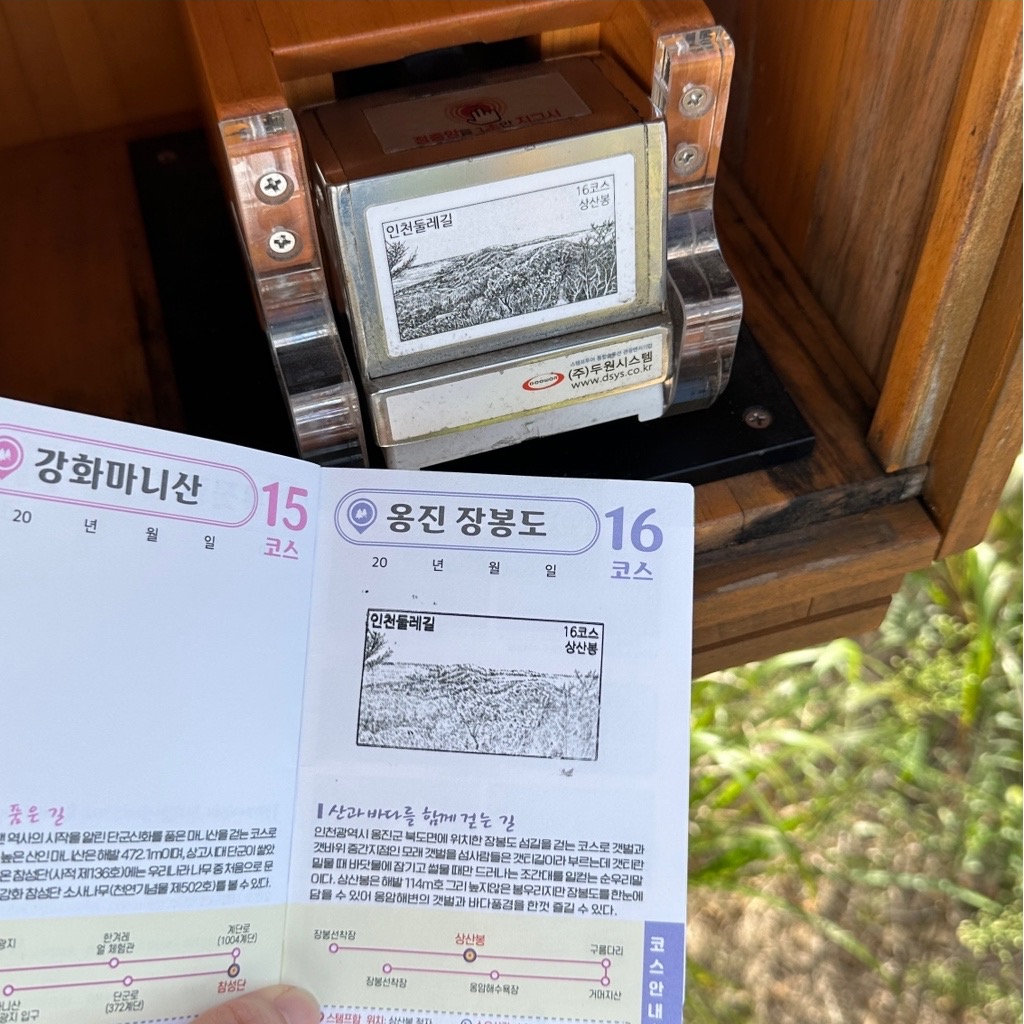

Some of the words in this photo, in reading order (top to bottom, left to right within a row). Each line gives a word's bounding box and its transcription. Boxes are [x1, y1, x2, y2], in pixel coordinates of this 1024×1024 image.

[516, 108, 562, 126] 지그시
[576, 181, 610, 200] 16코스
[579, 193, 611, 213] 상산봉
[386, 213, 454, 240] 인천둘레길
[568, 351, 653, 381] (주)두원시스템
[571, 364, 653, 389] www.dsys.co.kr
[34, 447, 203, 505] 강화마니산
[262, 481, 309, 532] 15
[12, 509, 32, 524] 20
[84, 518, 97, 534] 년
[146, 527, 158, 543] 월
[204, 535, 215, 551] 일
[263, 536, 298, 560] 코스
[386, 503, 446, 534] 옹진
[455, 507, 547, 537] 장봉도
[604, 506, 664, 553] 16
[371, 556, 388, 569] 20
[432, 558, 444, 573] 년
[488, 560, 500, 576] 월
[545, 563, 557, 578] 일
[610, 561, 654, 582] 코스
[370, 614, 436, 632] 인천둘레길
[564, 625, 600, 641] 16코스
[565, 641, 599, 656] 상산봉
[9, 803, 40, 827] 품은
[48, 806, 65, 827] 길
[328, 804, 365, 820] 산과
[367, 806, 416, 827] 바다를
[421, 806, 456, 826] 함께
[461, 812, 492, 829] 걷는
[499, 814, 516, 832] 길
[8, 833, 43, 844] 역사의
[46, 832, 80, 843] 시작을
[83, 832, 105, 843] 알린
[108, 831, 162, 843] 단군신화를
[165, 831, 185, 842] 품은
[188, 829, 230, 841] 마니산을
[229, 829, 248, 840] 걷는
[251, 828, 276, 839] 코스로
[315, 827, 368, 838] 인천광역시
[372, 829, 402, 841] 옹진군
[406, 832, 448, 843] 북도면에
[451, 834, 482, 846] 위치한
[485, 836, 516, 847] 장봉도
[519, 838, 551, 849] 섬길을
[554, 840, 575, 851] 걷는
[578, 841, 609, 852] 코스로
[613, 843, 644, 854] 갯벌과
[1, 851, 24, 863] 높은
[26, 851, 49, 862] 산인
[51, 850, 96, 861] 마니산은
[98, 849, 122, 860] 해발
[187, 847, 226, 858] 상고시대
[228, 845, 258, 857] 단군이
[314, 842, 345, 852] 갯바위
[348, 844, 400, 856] 중간지점인
[402, 847, 423, 857] 모래
[426, 848, 456, 860] 갯벌을
[459, 850, 511, 863] 섬사람들은
[514, 853, 566, 865] 갯티길이라
[568, 856, 610, 868] 부르는데
[613, 859, 644, 870] 갯티란
[149, 865, 193, 876] 우리나라
[191, 864, 211, 875] 나무
[214, 864, 223, 874] 중
[225, 862, 262, 873] 처음으로
[265, 861, 273, 871] 문
[312, 858, 334, 868] 밀물
[336, 859, 347, 868] 때
[349, 859, 392, 871] 바닷물에
[394, 862, 425, 873] 잠기고
[428, 864, 449, 875] 썰물
[452, 865, 472, 876] 때만
[476, 867, 518, 879] 드러나는
[521, 869, 563, 881] 조간대를
[566, 872, 597, 883] 일컫는
[601, 874, 643, 886] 순우리말
[0, 888, 23, 901] 강화
[26, 887, 61, 900] 참성단
[240, 880, 249, 889] 수
[251, 878, 270, 889] 있다.
[311, 874, 335, 883] 이다.
[338, 875, 379, 886] 상산봉은
[382, 876, 402, 887] 해발
[446, 880, 466, 891] 그리
[469, 882, 510, 894] 높지않은
[513, 885, 565, 897] 봉우리지만
[567, 887, 609, 899] 장봉도를
[611, 890, 643, 901] 한눈에
[310, 889, 332, 900] 담을
[336, 890, 346, 900] 수
[350, 890, 371, 901] 있어
[375, 892, 429, 904] 옹암해변의
[433, 895, 465, 907] 갯벌과
[469, 898, 524, 911] 바다풍경을
[528, 901, 549, 912] 한껏
[553, 902, 574, 913] 즐길
[578, 904, 588, 913] 수
[592, 904, 616, 915] 있다.
[103, 931, 130, 943] 한겨레
[217, 932, 258, 946] (1004계단)
[227, 923, 251, 935] 계단로
[313, 929, 356, 941] 장봉선착장
[454, 932, 486, 947] 상산봉
[96, 944, 107, 956] 얼
[108, 942, 135, 955] 체험관
[590, 944, 624, 956] 구름다리
[113, 990, 138, 1003] 단군로
[217, 979, 247, 994] 참성단
[366, 976, 408, 988] 장봉선착장
[469, 982, 519, 995] 옹암해수욕장
[588, 989, 622, 1001] 거머지산
[21, 1009, 40, 1022] 입구
[105, 999, 144, 1014] (372계단)
